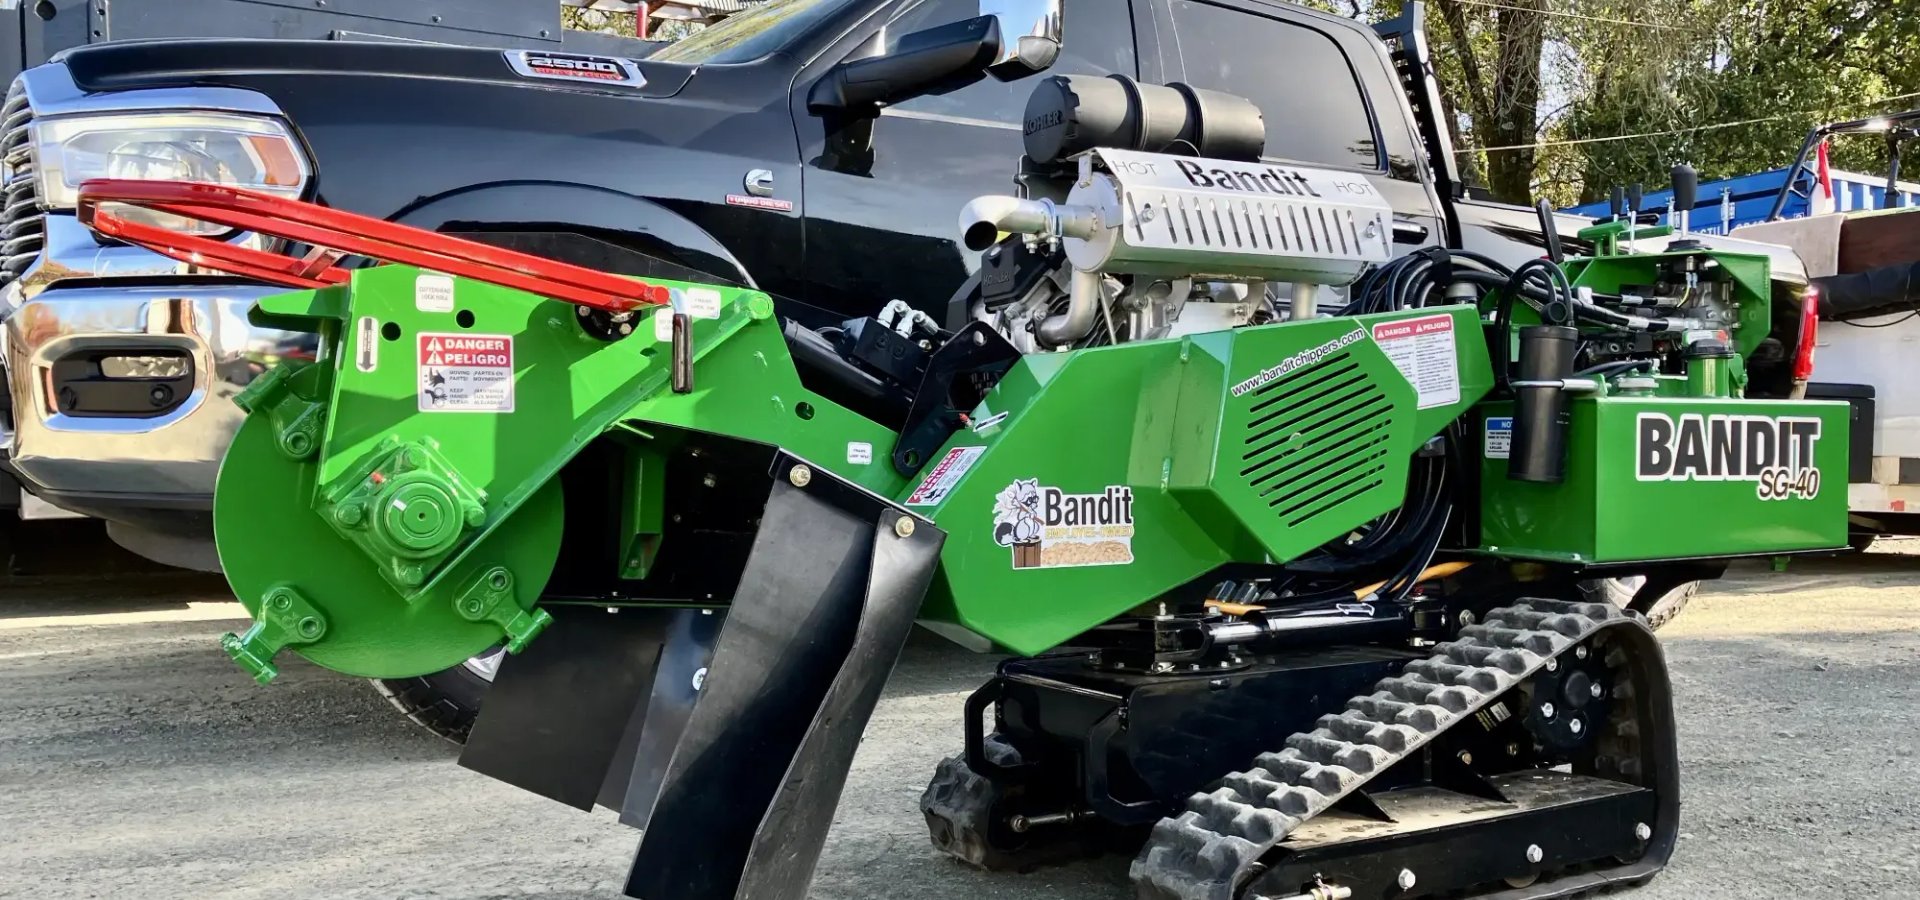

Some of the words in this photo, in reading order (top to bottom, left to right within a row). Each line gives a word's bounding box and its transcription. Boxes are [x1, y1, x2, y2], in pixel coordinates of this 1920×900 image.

[528, 56, 618, 73] 2500
[1112, 160, 1157, 176] HOT
[1173, 159, 1320, 198] Bandit
[1333, 180, 1374, 196] HOT
[444, 338, 505, 351] DANGER
[1384, 326, 1411, 337] DANGER
[444, 353, 507, 365] PELIGRO
[1232, 328, 1364, 396] www.banditchippers.com
[1639, 417, 1819, 476] BANDIT
[1759, 469, 1818, 497] SG-40
[1045, 488, 1132, 526] Bandit
